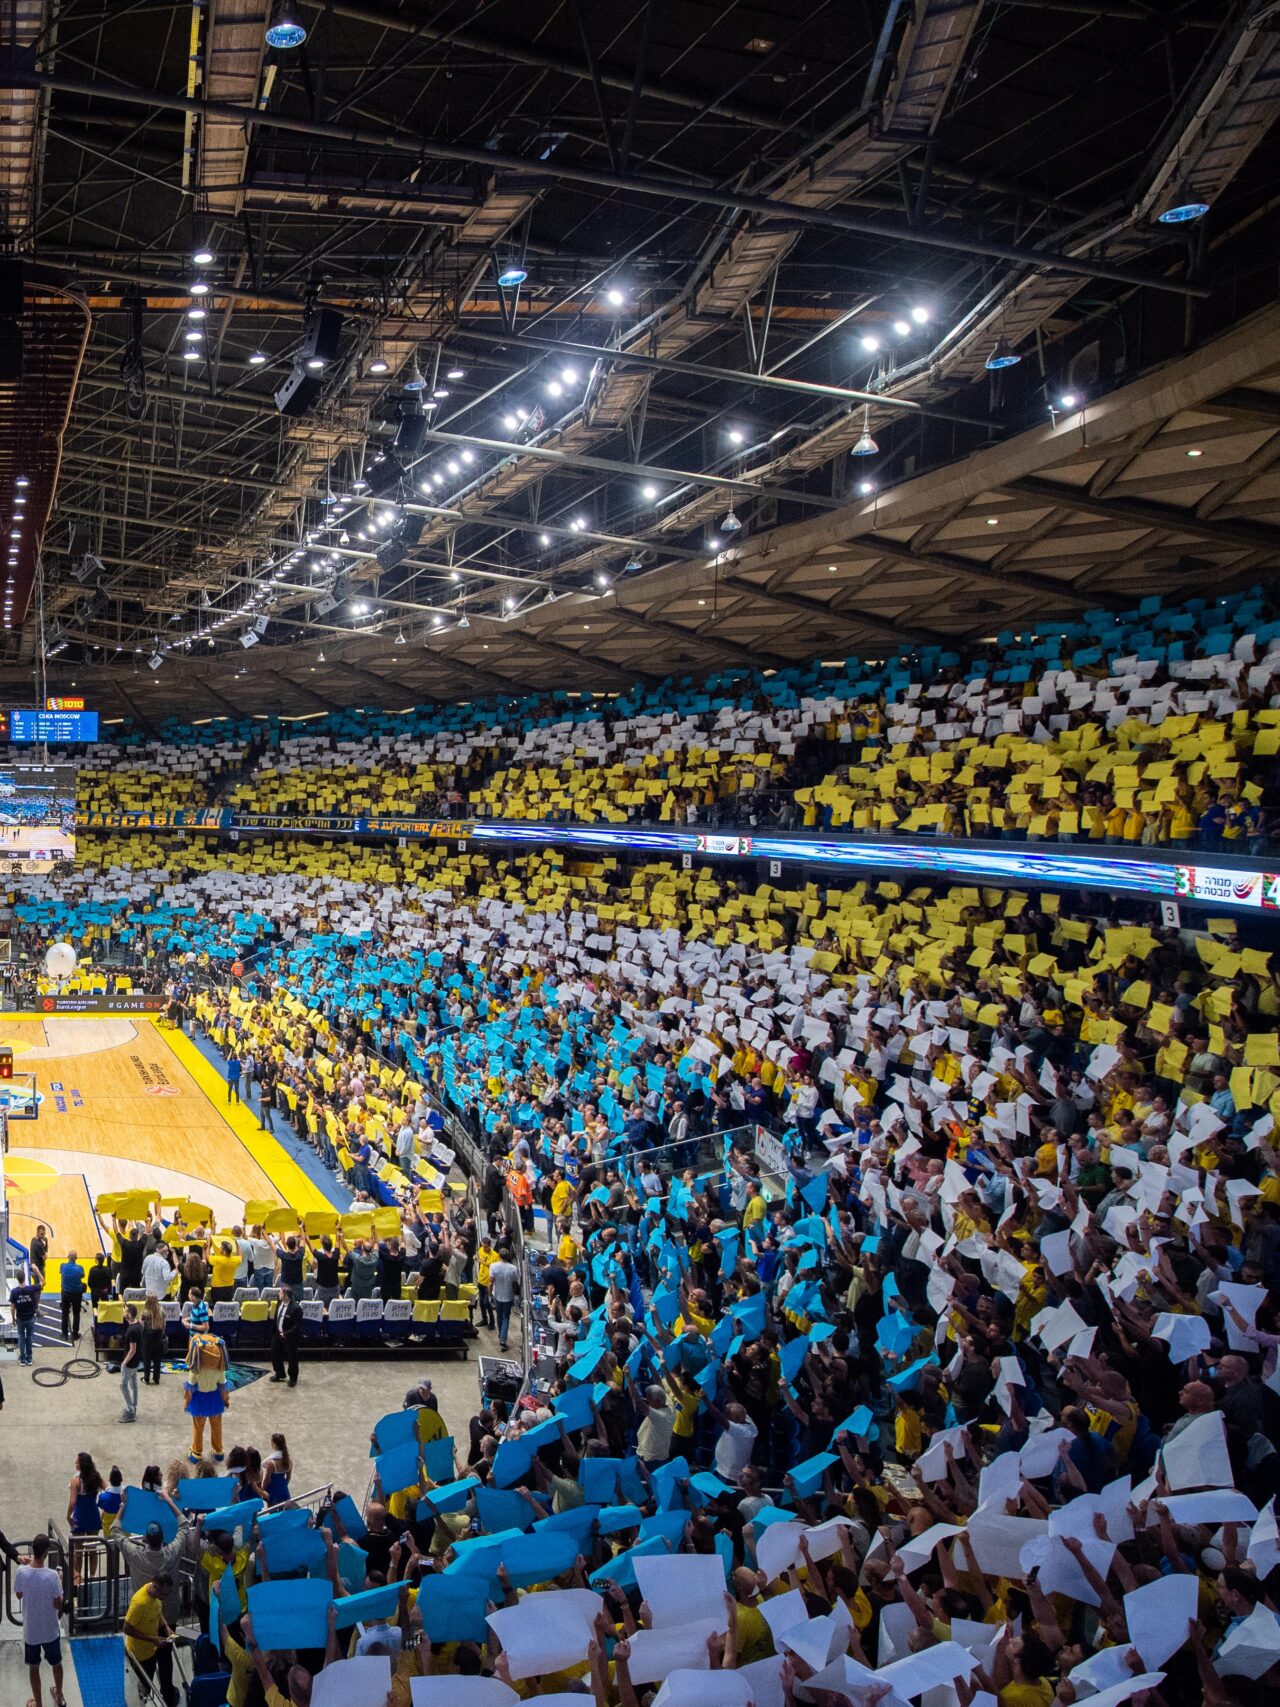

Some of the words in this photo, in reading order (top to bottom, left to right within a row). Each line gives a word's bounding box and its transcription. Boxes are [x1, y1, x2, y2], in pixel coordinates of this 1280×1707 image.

[75, 809, 177, 827] MACCABI
[697, 836, 705, 851] 2
[741, 837, 749, 854] 3
[684, 856, 690, 866] 2
[773, 864, 779, 874] 3
[1177, 868, 1190, 894] 3
[1204, 876, 1232, 887] מנורה
[1194, 886, 1231, 897] מבטחים
[1166, 906, 1175, 922] 3
